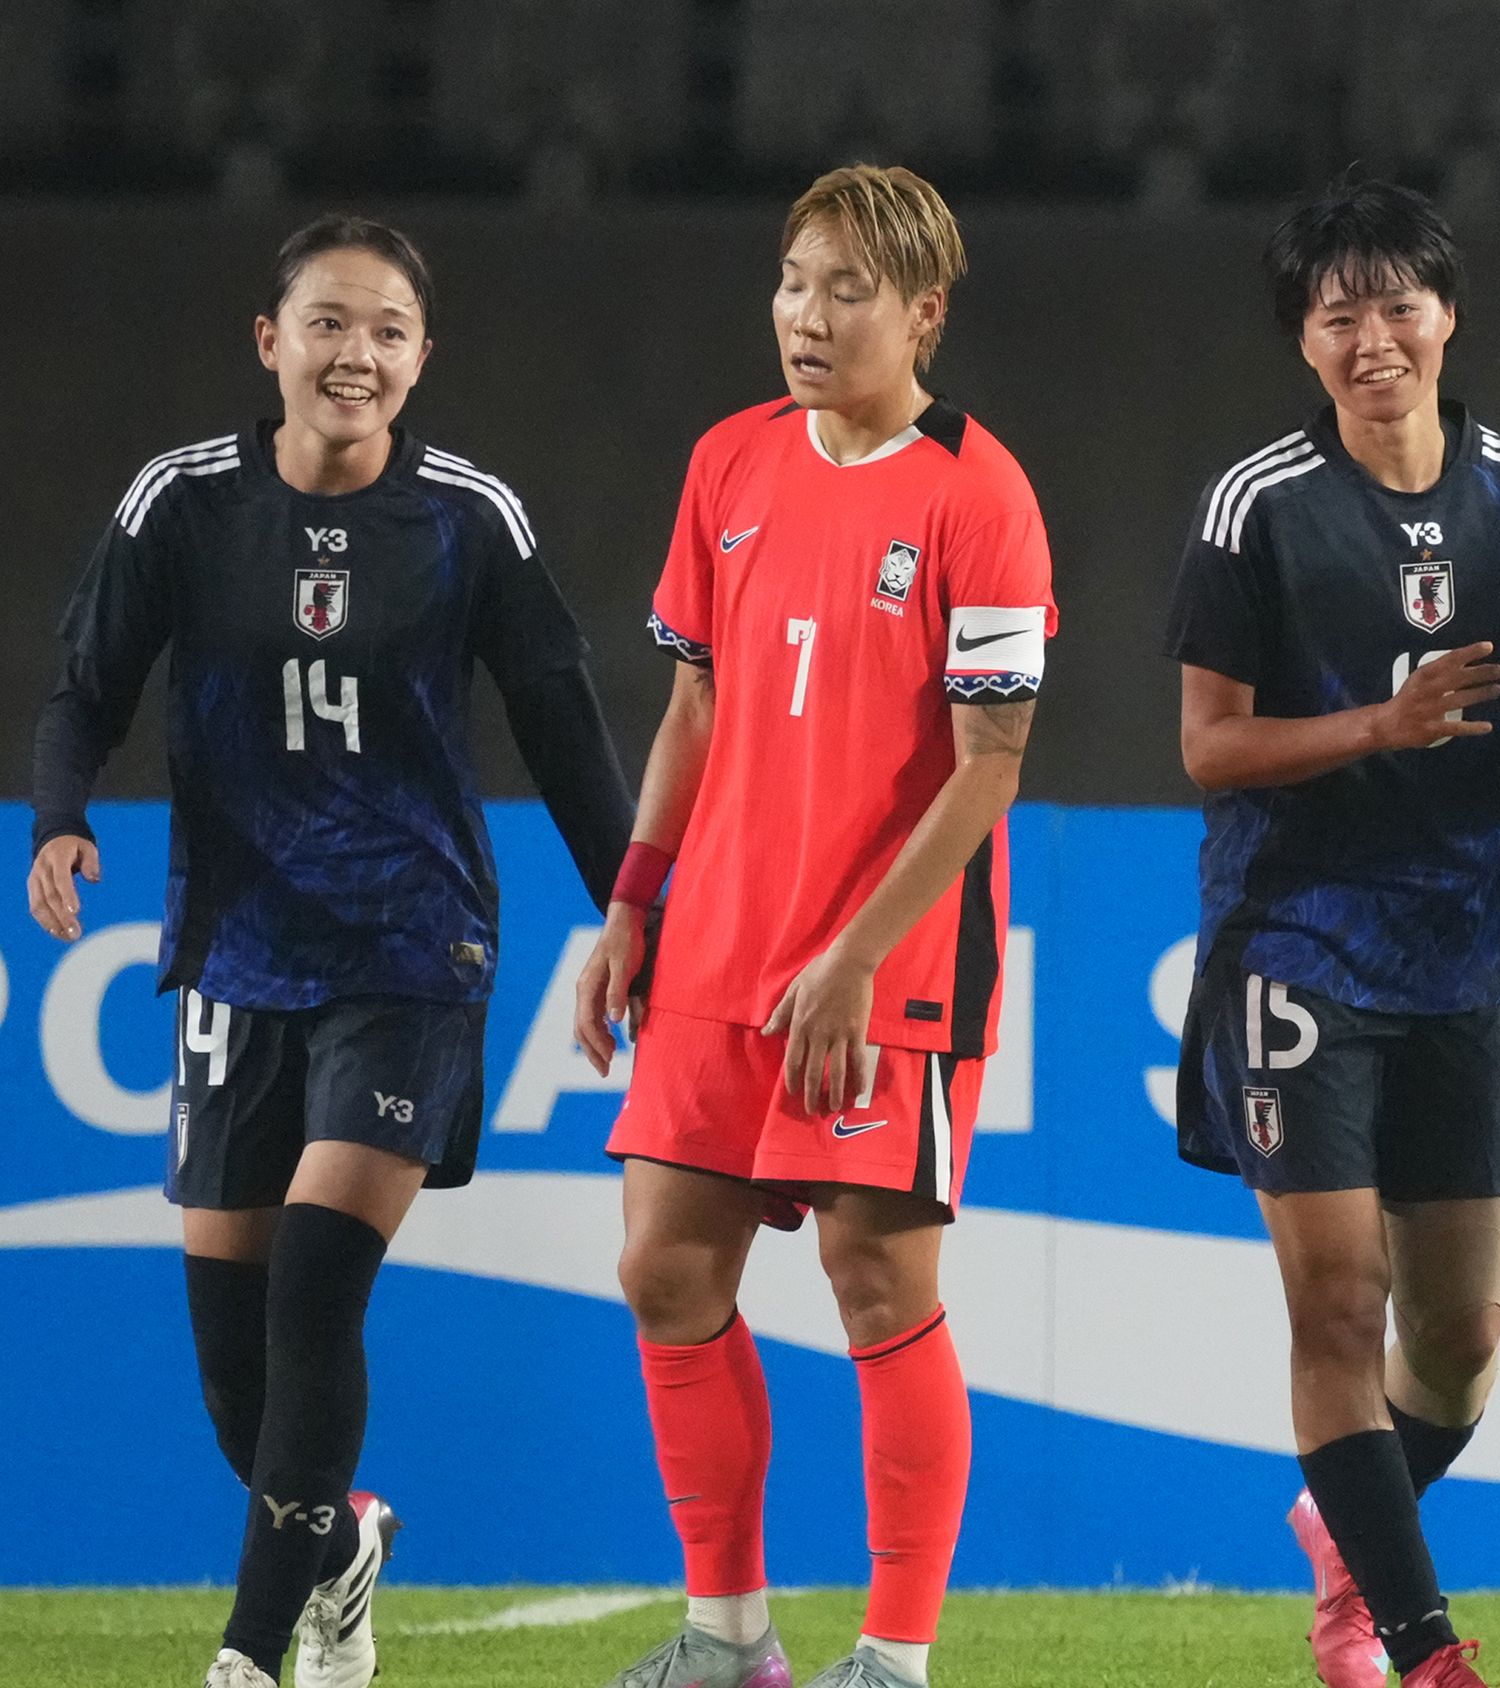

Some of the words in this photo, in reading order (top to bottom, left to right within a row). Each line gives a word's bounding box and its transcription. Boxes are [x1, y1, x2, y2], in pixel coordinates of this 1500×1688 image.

[305, 527, 348, 553] Y-3
[1400, 522, 1444, 547] Y-3
[309, 572, 336, 580] JAPAN
[1413, 565, 1440, 573] JAPAN
[870, 597, 904, 617] KOREA
[787, 615, 817, 717] 7
[283, 657, 361, 753] 14
[178, 986, 231, 1087] 14
[1246, 974, 1319, 1070] 15
[373, 1090, 415, 1123] Y-3
[262, 1494, 336, 1537] Y-3
